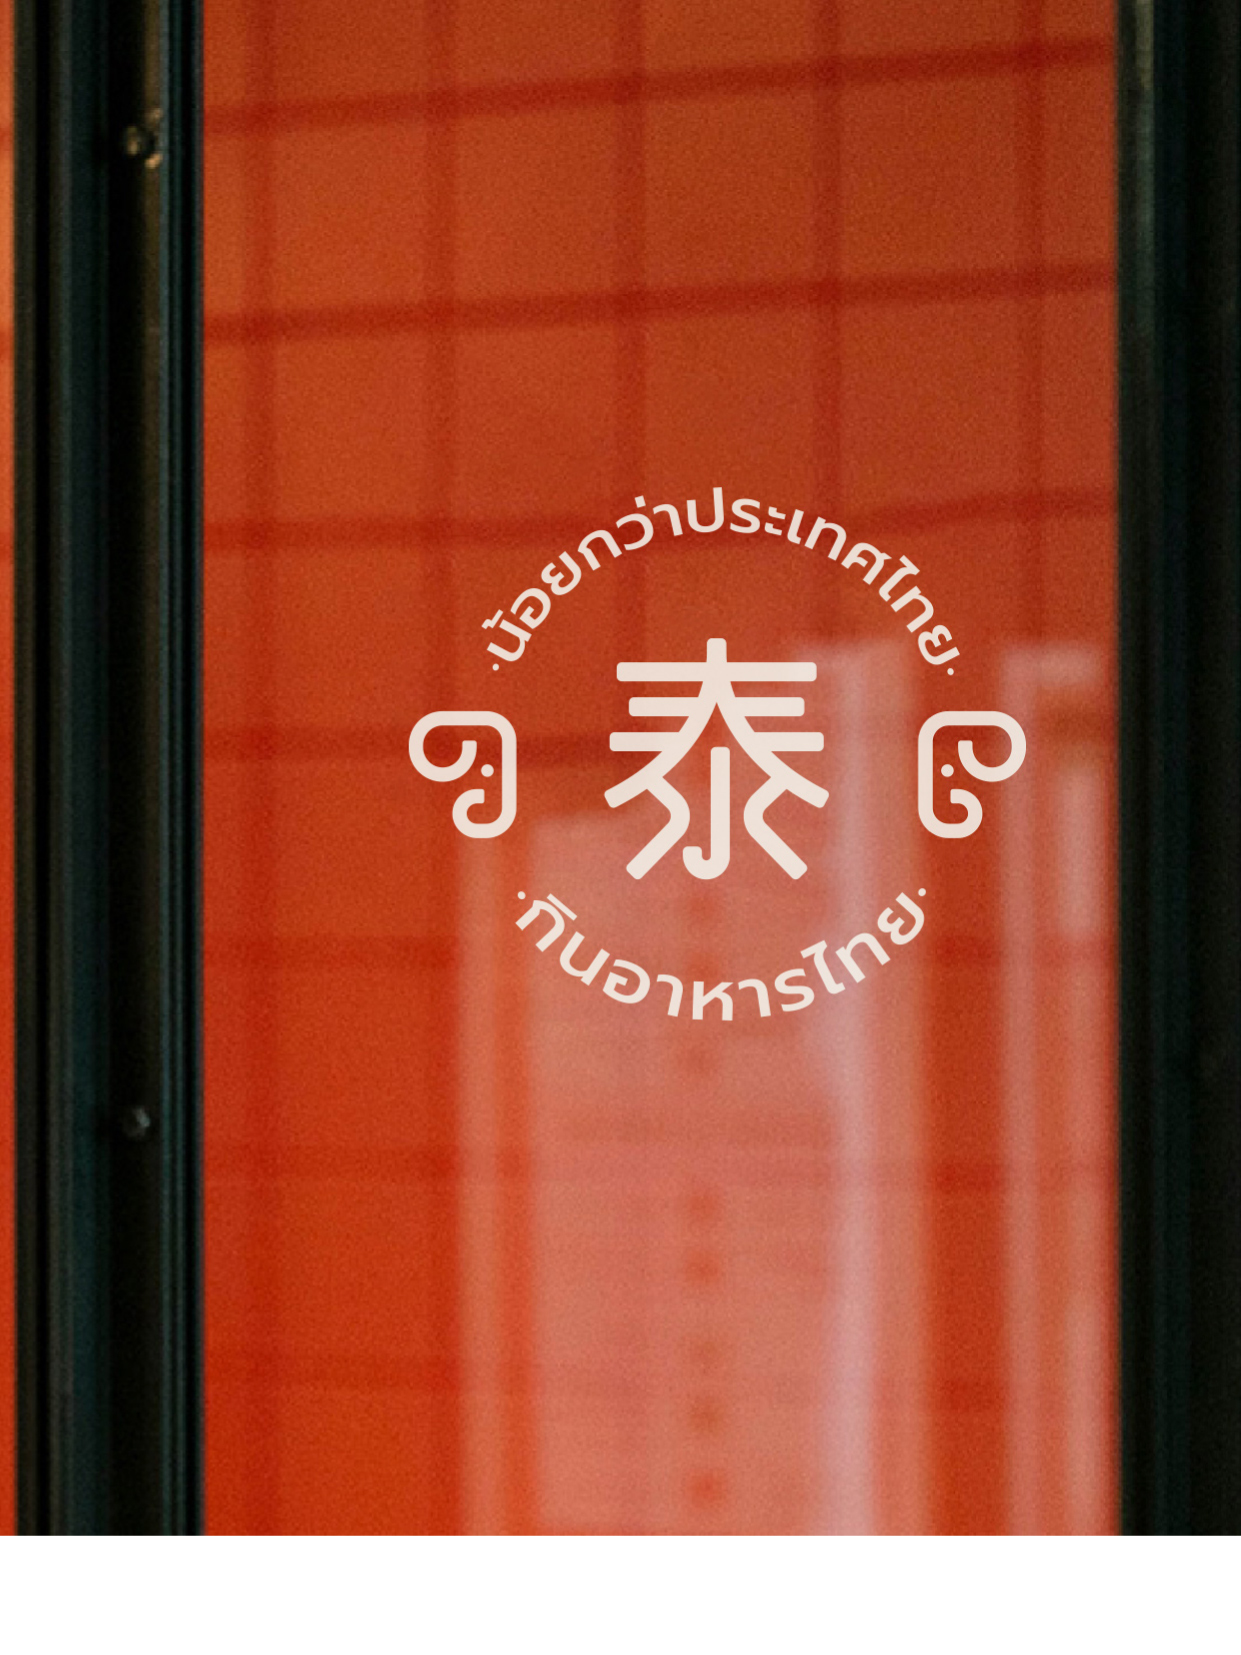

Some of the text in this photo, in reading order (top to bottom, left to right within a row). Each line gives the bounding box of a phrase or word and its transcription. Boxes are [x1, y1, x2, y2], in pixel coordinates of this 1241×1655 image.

[481, 487, 960, 667] น้อยกว่าประเทศไทย
[604, 638, 830, 880] 泰
[515, 893, 926, 1021] กินอาหารไทย
